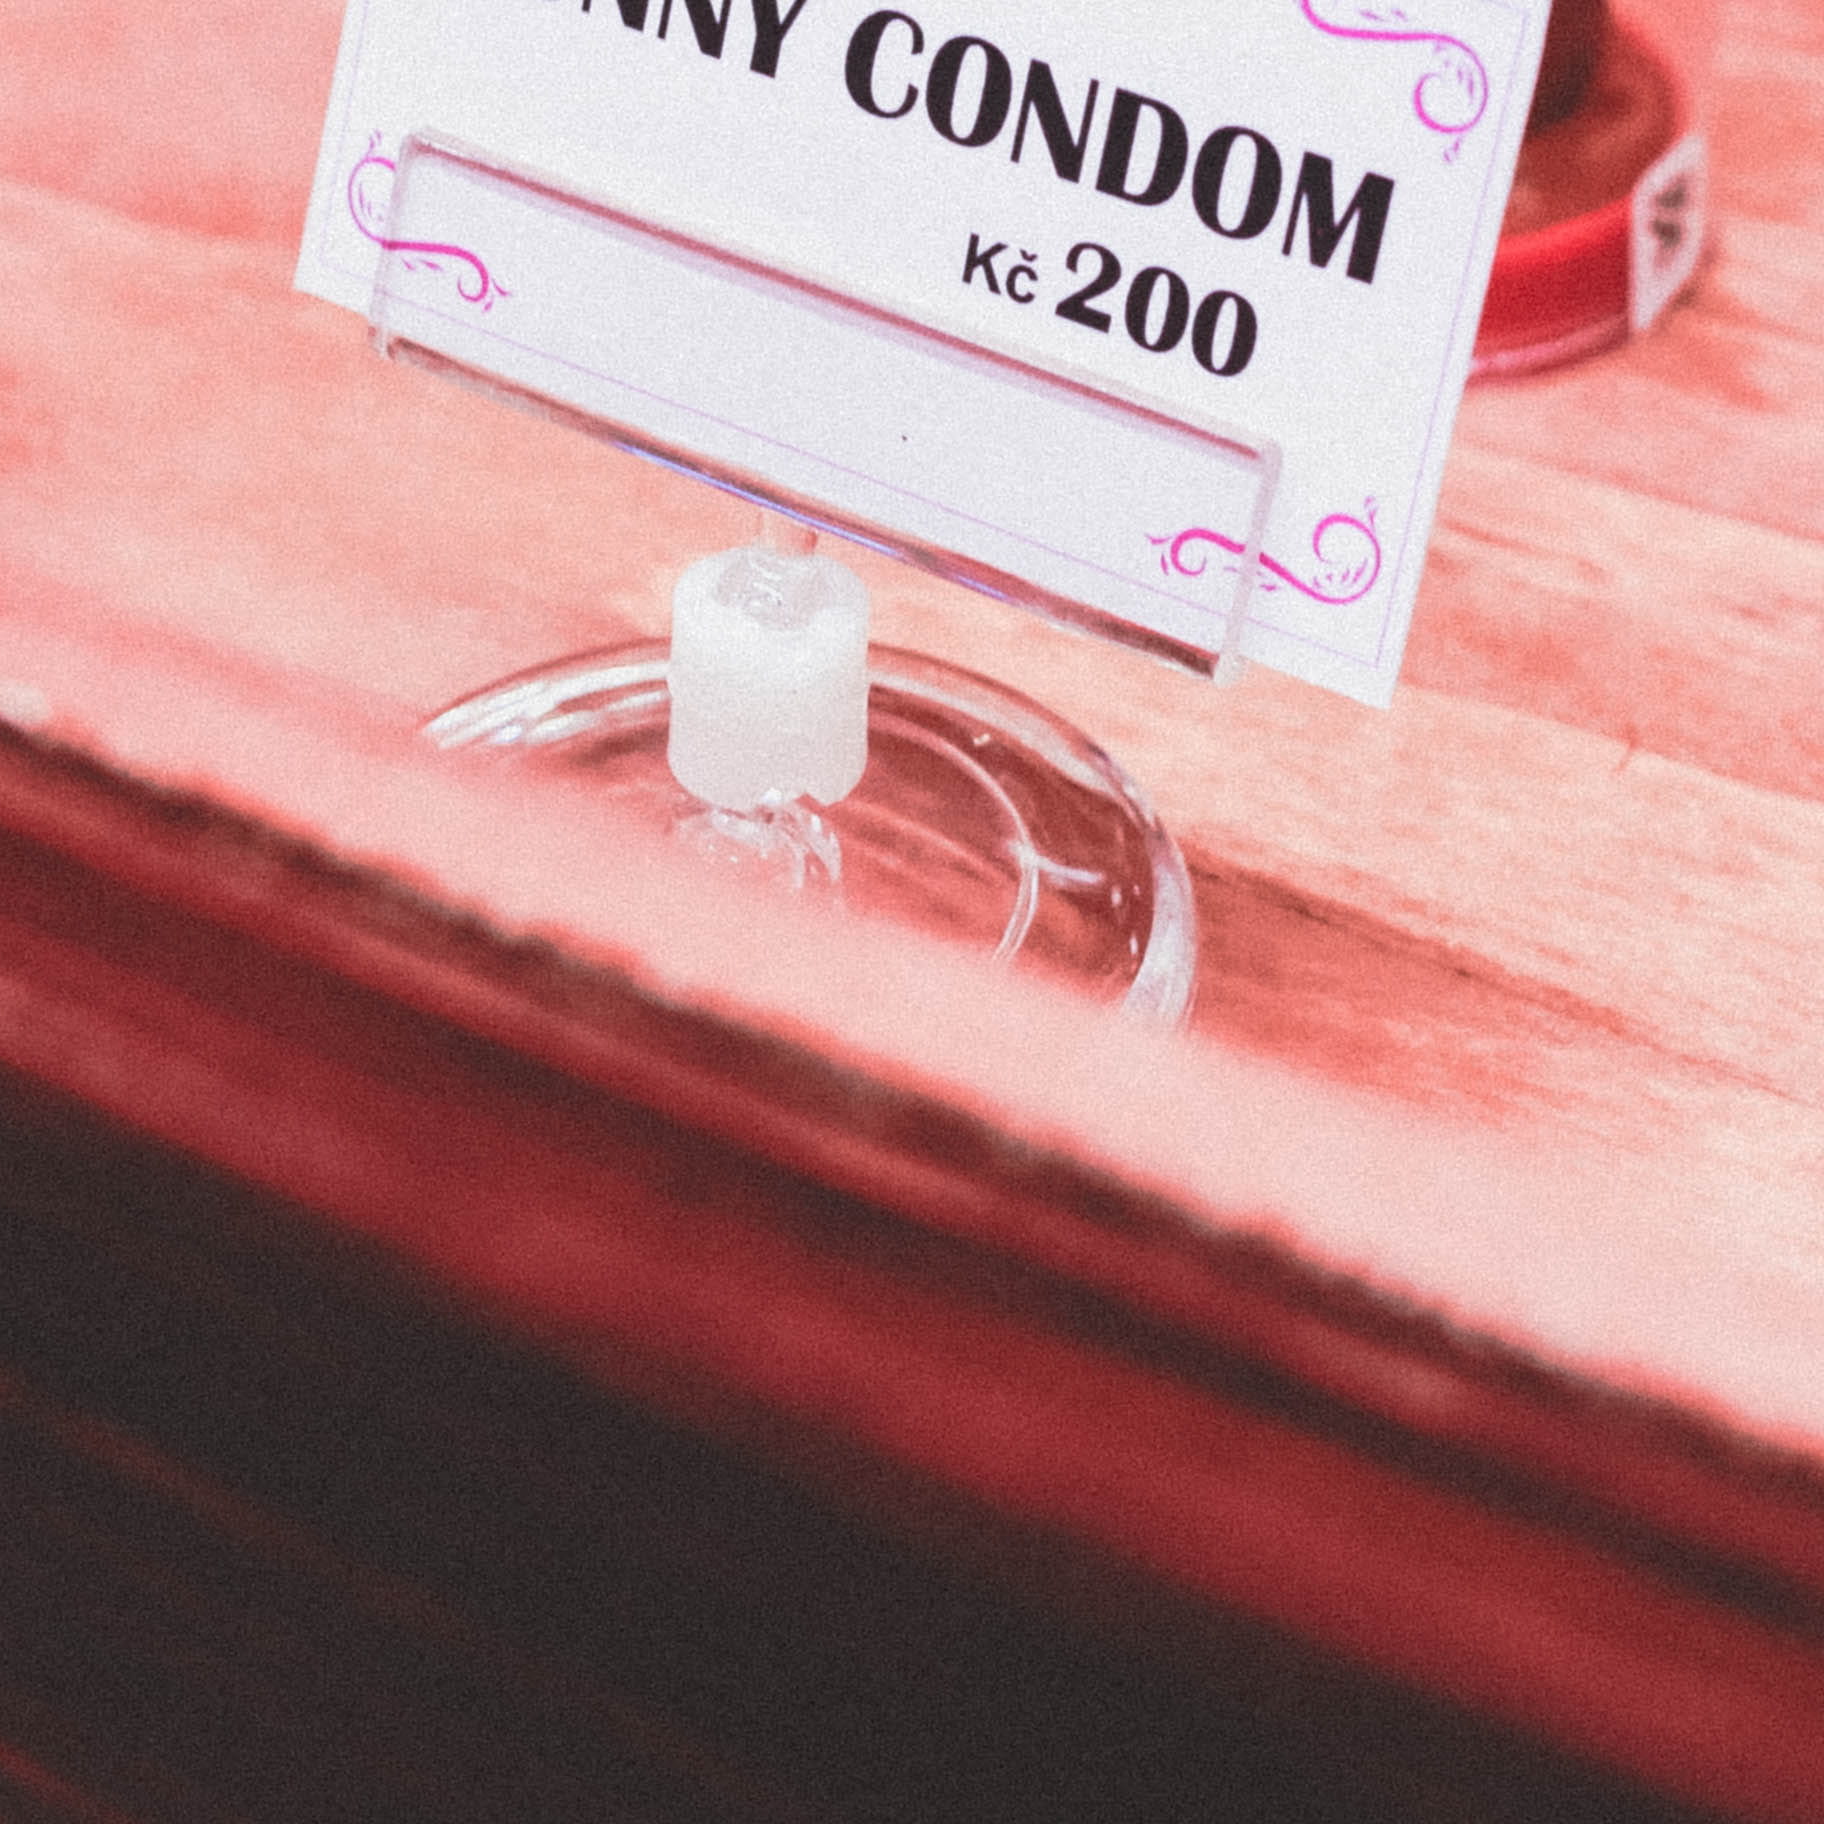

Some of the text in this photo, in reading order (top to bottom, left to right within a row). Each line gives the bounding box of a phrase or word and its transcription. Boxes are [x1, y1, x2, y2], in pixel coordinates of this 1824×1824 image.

[843, 9, 1396, 285] CONDOM
[961, 233, 1259, 378] Kč 200
